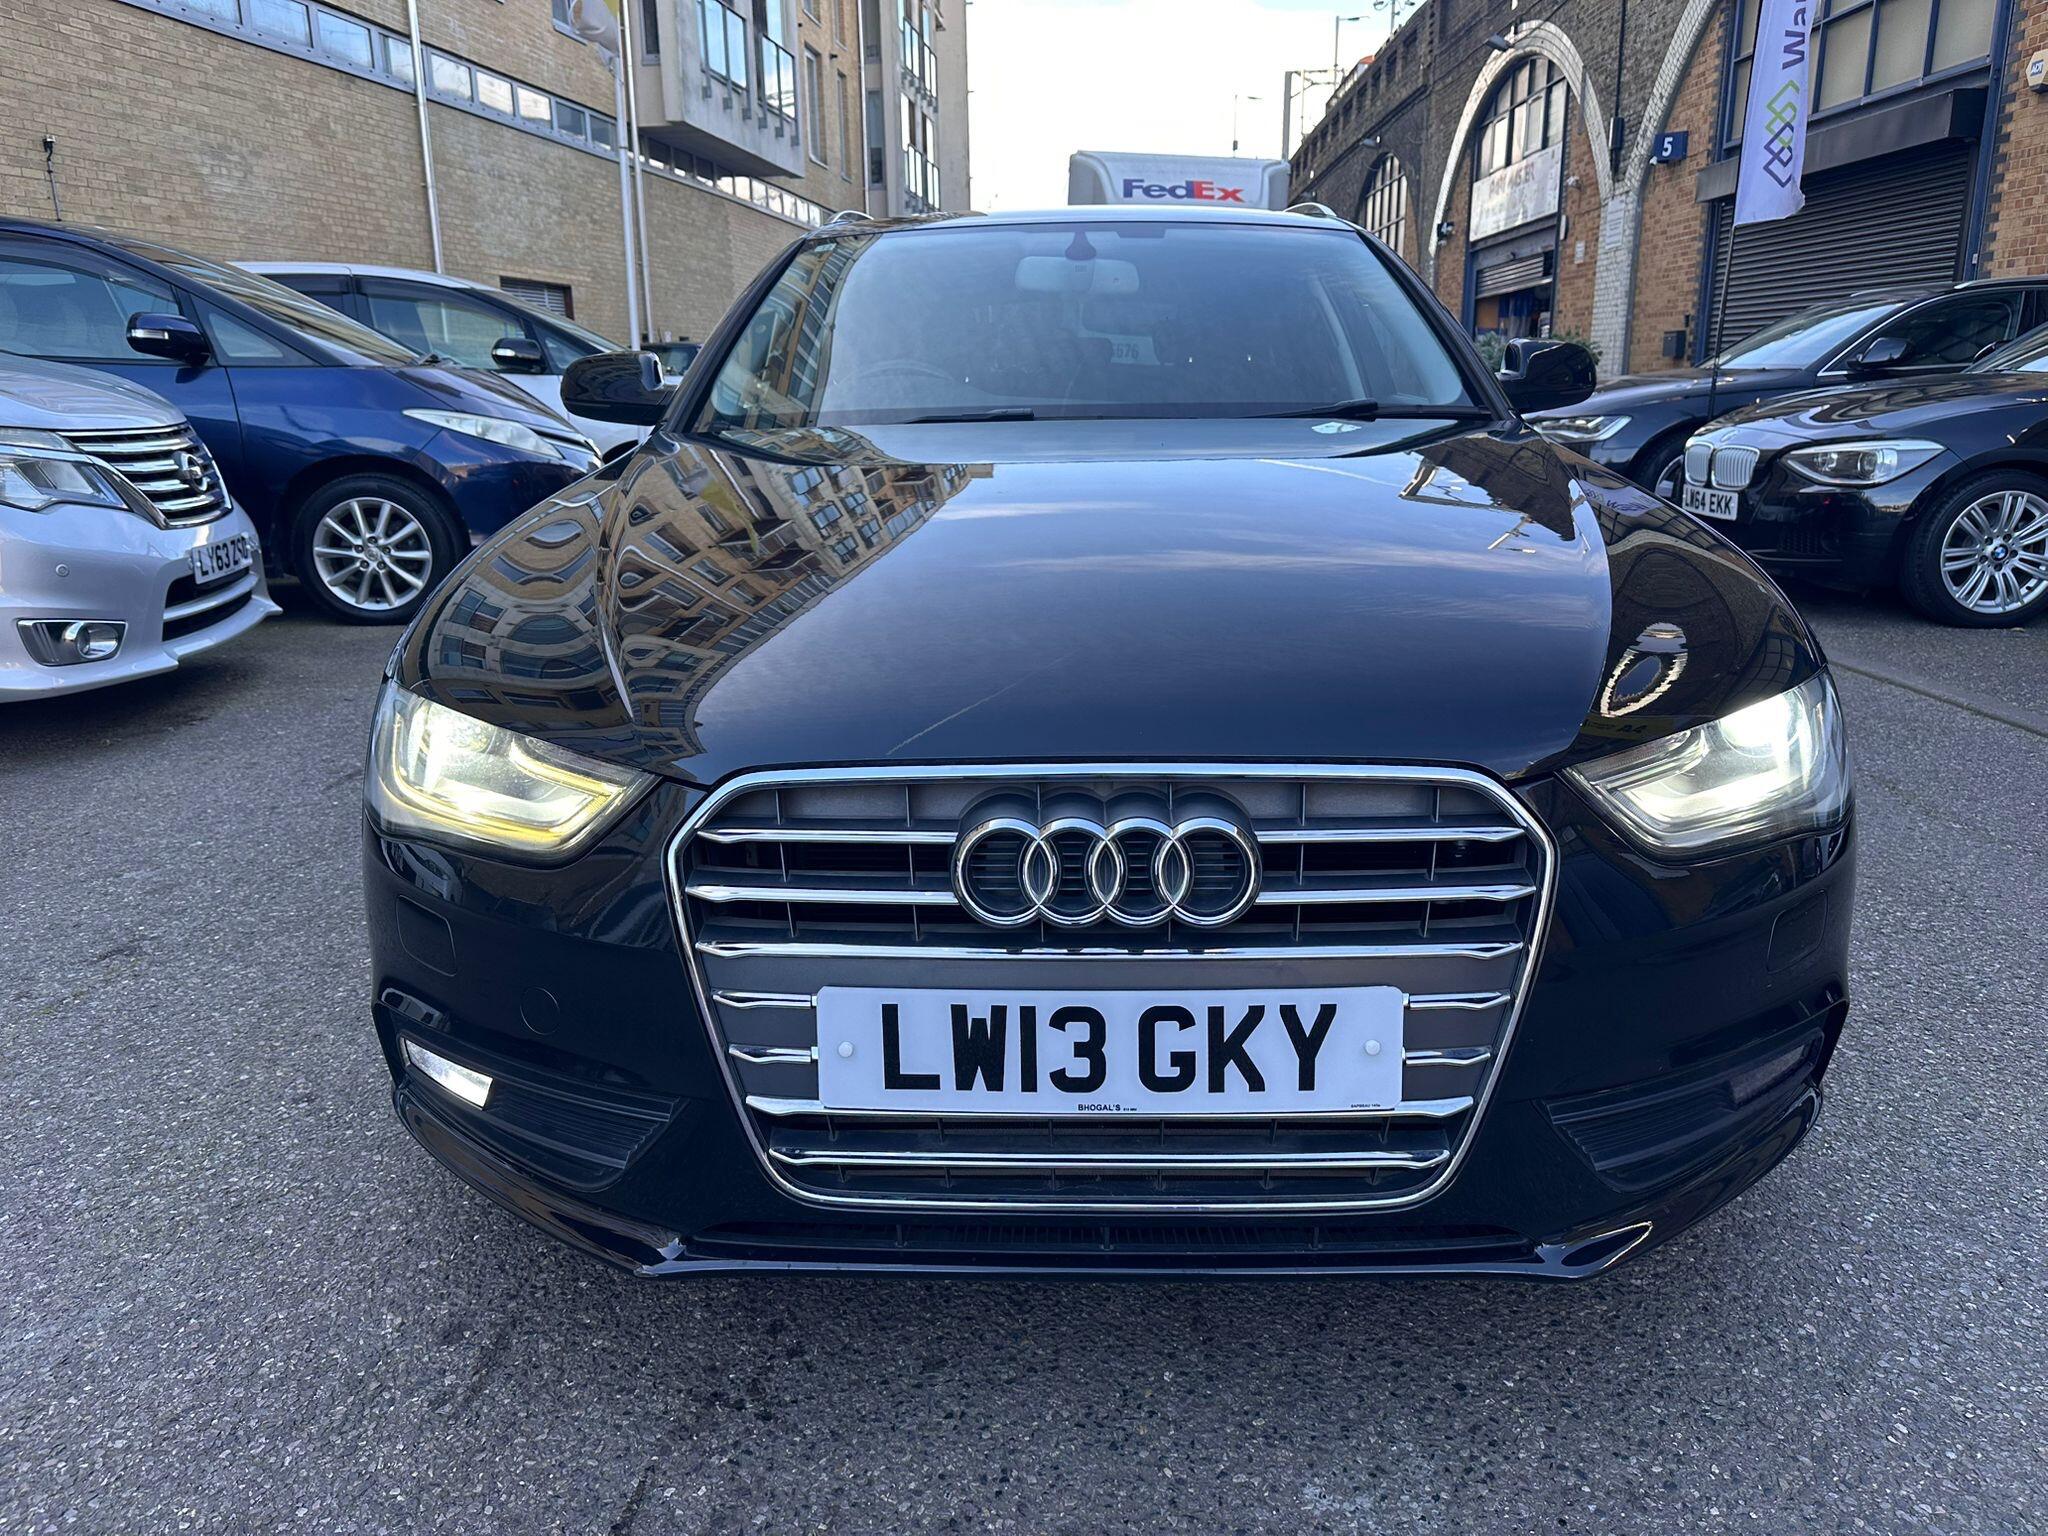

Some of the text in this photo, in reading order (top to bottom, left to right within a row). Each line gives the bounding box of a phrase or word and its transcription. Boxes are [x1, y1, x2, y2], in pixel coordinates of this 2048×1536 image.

[1782, 0, 1807, 70] Wa
[1662, 136, 1673, 157] 5
[1122, 178, 1246, 203] FedEx
[1709, 493, 1732, 515] EKK
[198, 543, 231, 577] LY63
[881, 1003, 1337, 1093] LW13 GKY
[1077, 1103, 1121, 1112] BHOGAL'S
